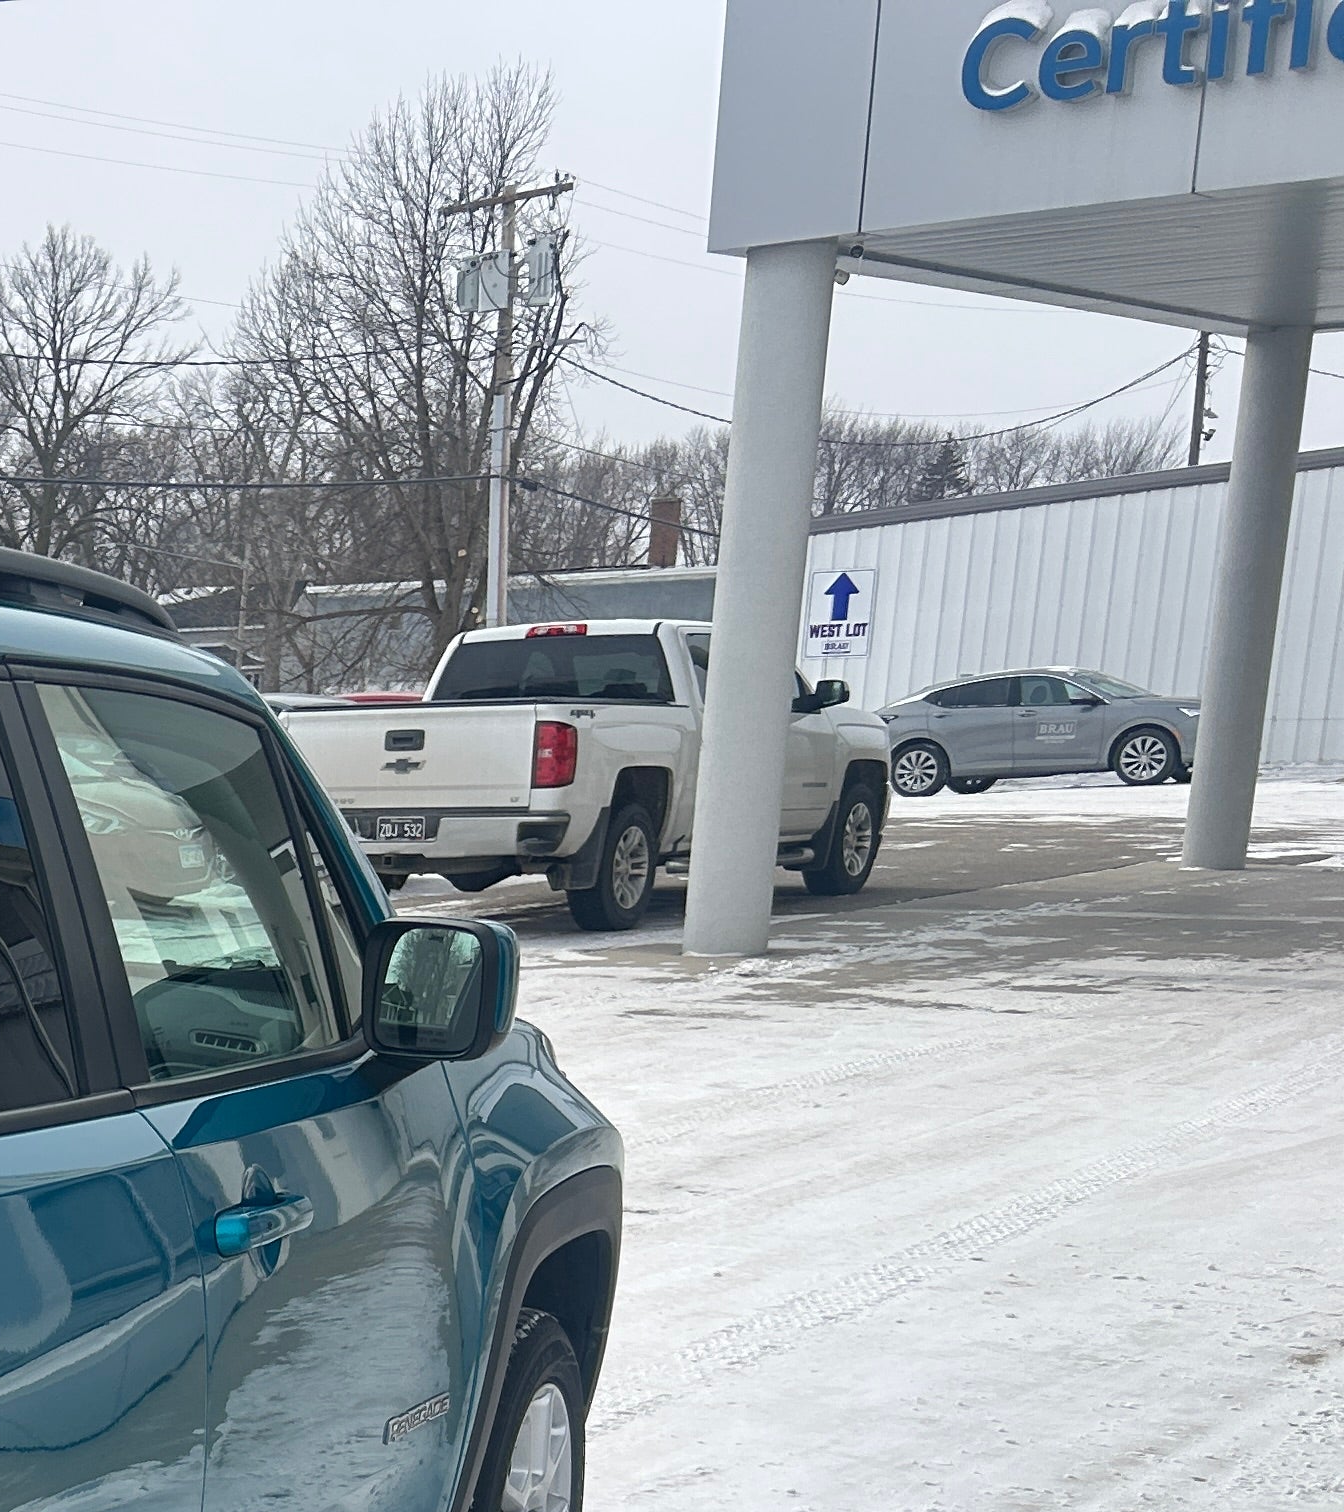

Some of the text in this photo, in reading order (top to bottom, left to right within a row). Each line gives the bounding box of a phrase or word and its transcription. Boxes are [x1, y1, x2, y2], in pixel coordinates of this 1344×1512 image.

[961, 0, 1344, 111] Certifi
[809, 622, 868, 638] WEST LOT
[1039, 723, 1075, 734] BRAU
[404, 823, 422, 837] 532
